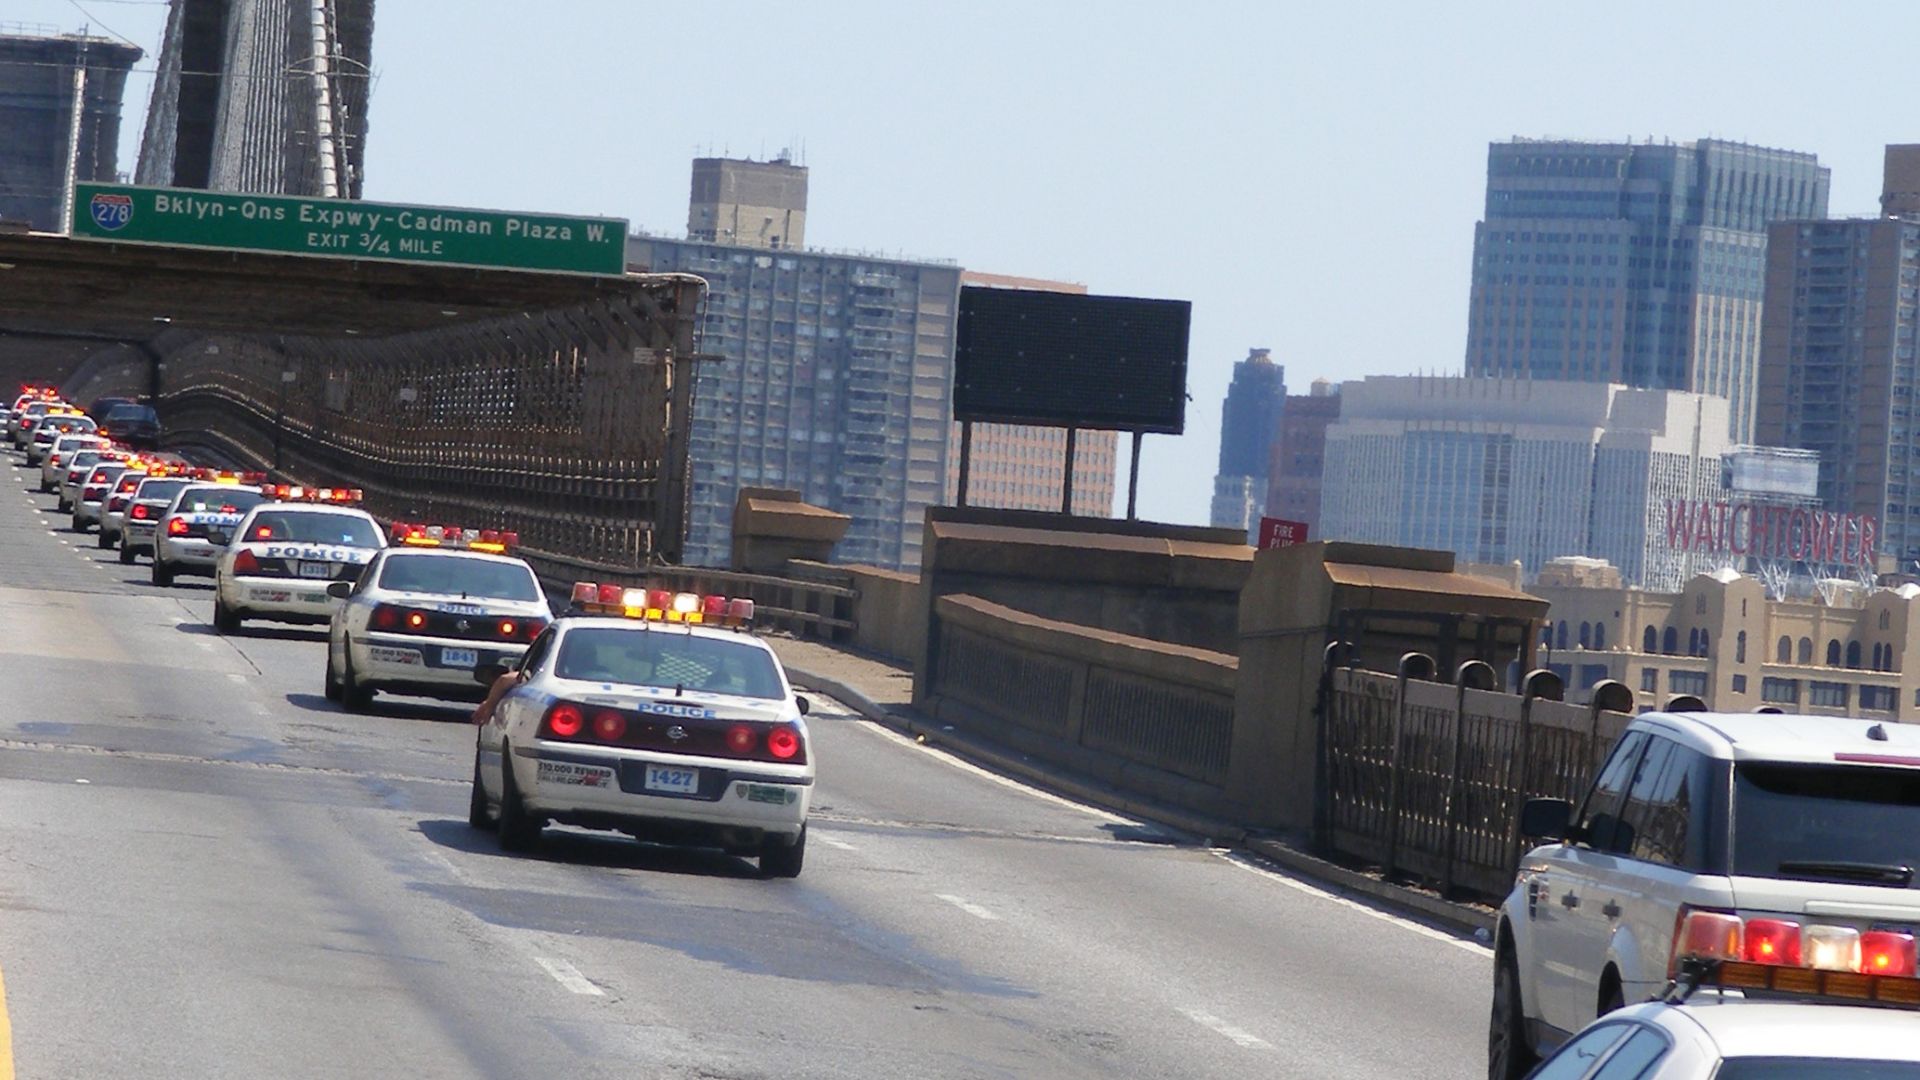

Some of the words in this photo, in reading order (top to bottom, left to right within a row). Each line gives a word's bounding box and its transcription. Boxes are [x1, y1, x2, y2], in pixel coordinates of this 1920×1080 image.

[97, 203, 129, 222] 278
[154, 194, 286, 220] Bklyn-Qns
[299, 204, 492, 236] Expwy-Cadman
[505, 218, 572, 241] Plaza
[587, 223, 611, 244] W.
[307, 232, 350, 248] EXIT
[399, 238, 444, 255] MILE
[194, 515, 239, 526] POLI
[1273, 524, 1294, 539] FIRE
[1666, 499, 1878, 567] WATCHTOWER
[266, 546, 361, 563] POLICE
[437, 602, 489, 616] POLICE
[637, 703, 717, 720] POLICE
[650, 768, 694, 787] 1427
